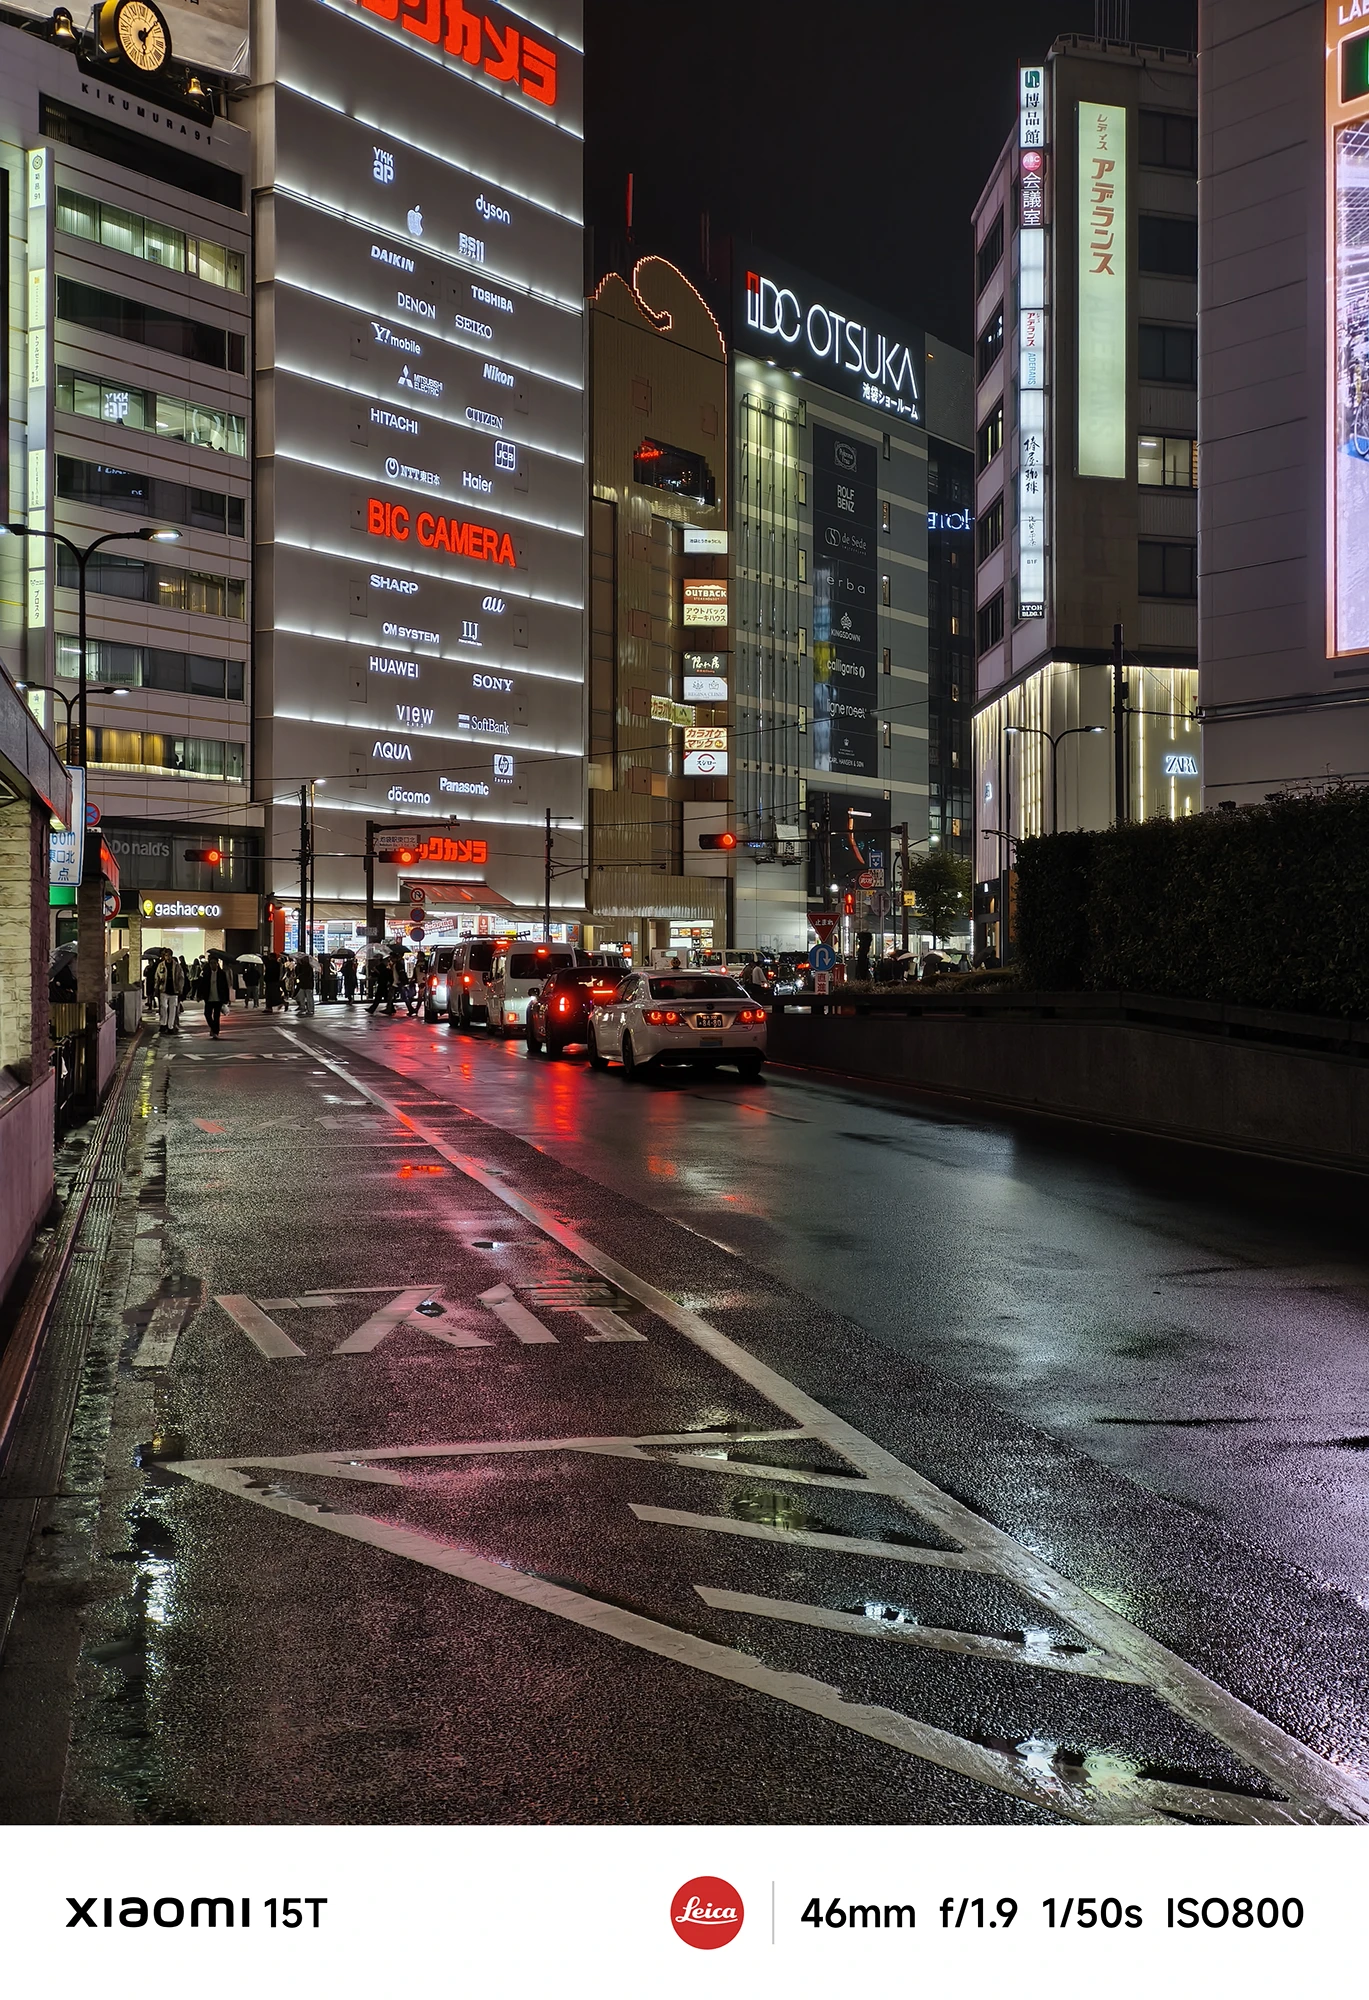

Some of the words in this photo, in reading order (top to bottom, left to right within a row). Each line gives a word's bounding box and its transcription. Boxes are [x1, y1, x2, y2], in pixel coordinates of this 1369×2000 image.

[1024, 92, 1041, 145] 博品館
[1096, 113, 1108, 151] レディス
[373, 146, 395, 166] YKK
[373, 161, 395, 184] ap
[474, 193, 512, 225] dyson
[1022, 171, 1042, 227] 会議室
[1089, 157, 1116, 276] アデランス
[370, 244, 415, 273] DAIKIN
[397, 291, 437, 320] DENON
[471, 284, 514, 314] TOSHIBA
[454, 314, 493, 340] SEIKO
[806, 303, 919, 400] OTSUKA
[482, 362, 516, 388] Nikon
[1027, 352, 1037, 385] ADERANS
[413, 373, 443, 391] MITSUBISHI
[413, 381, 440, 397] ELECTRIC
[862, 380, 919, 421] 池袋ショールーム
[370, 407, 419, 434] HITACHI
[465, 406, 504, 430] CITIZEN
[496, 450, 515, 463] JCB
[400, 464, 442, 487] NTT東日本
[462, 470, 494, 494] Haier
[836, 484, 855, 501] ROLF
[836, 499, 855, 513] BENZ
[367, 497, 410, 541] BIC
[416, 511, 517, 568] CAMERA
[841, 532, 851, 545] de
[851, 535, 867, 551] Sede
[369, 574, 419, 595] SHARP
[685, 589, 727, 598] OUTBACK
[825, 575, 866, 595] erba
[481, 595, 506, 614] au
[685, 607, 726, 615] アウトバック
[685, 614, 727, 623] ステーキハウス
[382, 622, 398, 637] OM
[398, 626, 440, 644] SYSTEM
[830, 628, 861, 643] KINGSDOWN
[369, 655, 419, 678] HUAWEI
[826, 658, 859, 677] calligaris
[472, 673, 514, 692] SONY
[471, 716, 510, 735] SoftBank
[686, 729, 724, 739] カラオケ
[372, 741, 412, 761] AQUA
[686, 739, 714, 748] マック
[1165, 755, 1199, 775] ZARA
[439, 777, 490, 797] Panasonic
[109, 840, 170, 857] Donald's
[417, 836, 488, 864] ックカメラ
[815, 918, 834, 926] 止まれ
[817, 973, 827, 995] 直進
